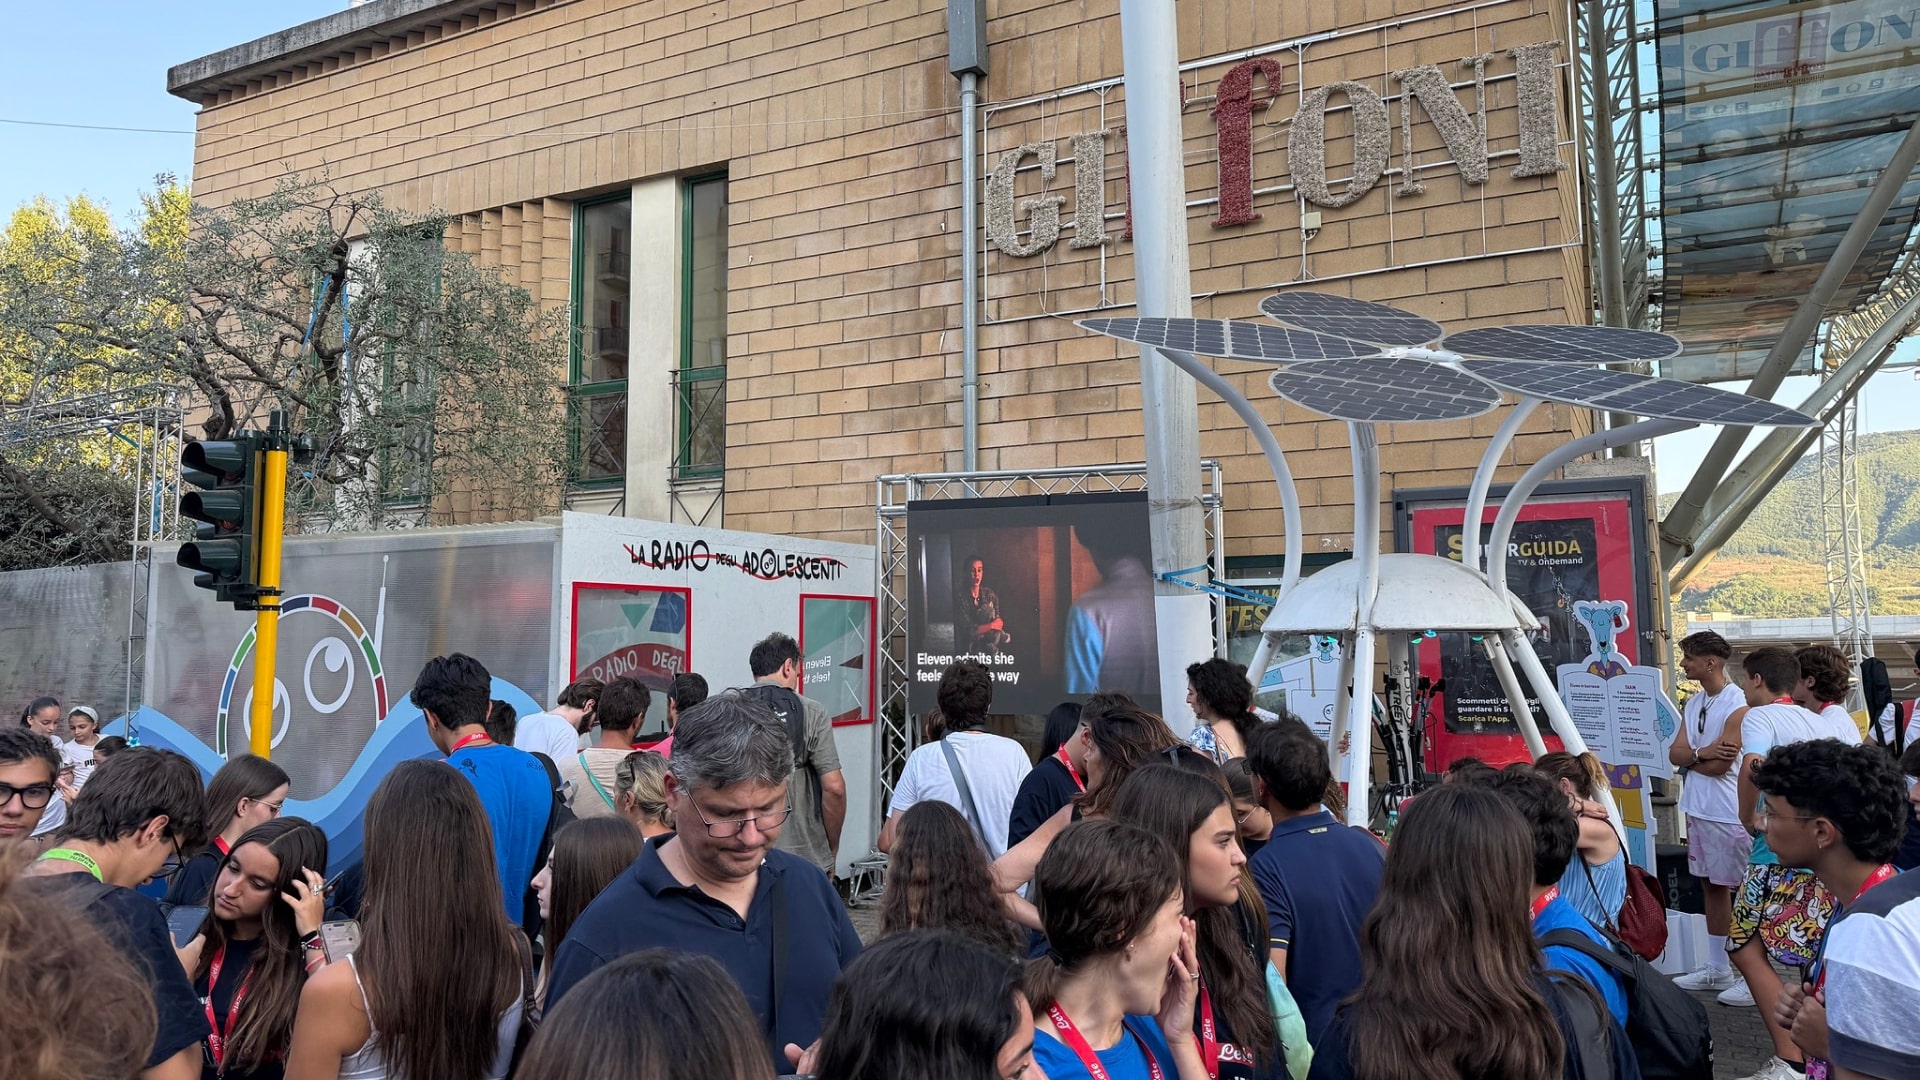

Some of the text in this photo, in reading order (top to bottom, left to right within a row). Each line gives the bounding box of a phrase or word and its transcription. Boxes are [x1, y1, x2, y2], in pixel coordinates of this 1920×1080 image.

[985, 40, 1567, 258] GIfONI
[1447, 534, 1582, 560] SRGUIDA
[631, 540, 841, 581] LA RADIO DEGLI ADOLESCENTI
[1538, 557, 1583, 566] OnDemand
[592, 649, 685, 684] RADIO DEGL
[917, 652, 952, 665] Eleven
[994, 653, 1014, 665] she
[916, 669, 943, 682] feels
[997, 671, 1019, 685] way
[1457, 705, 1494, 713] guardare
[1090, 1062, 1107, 1080] ete
